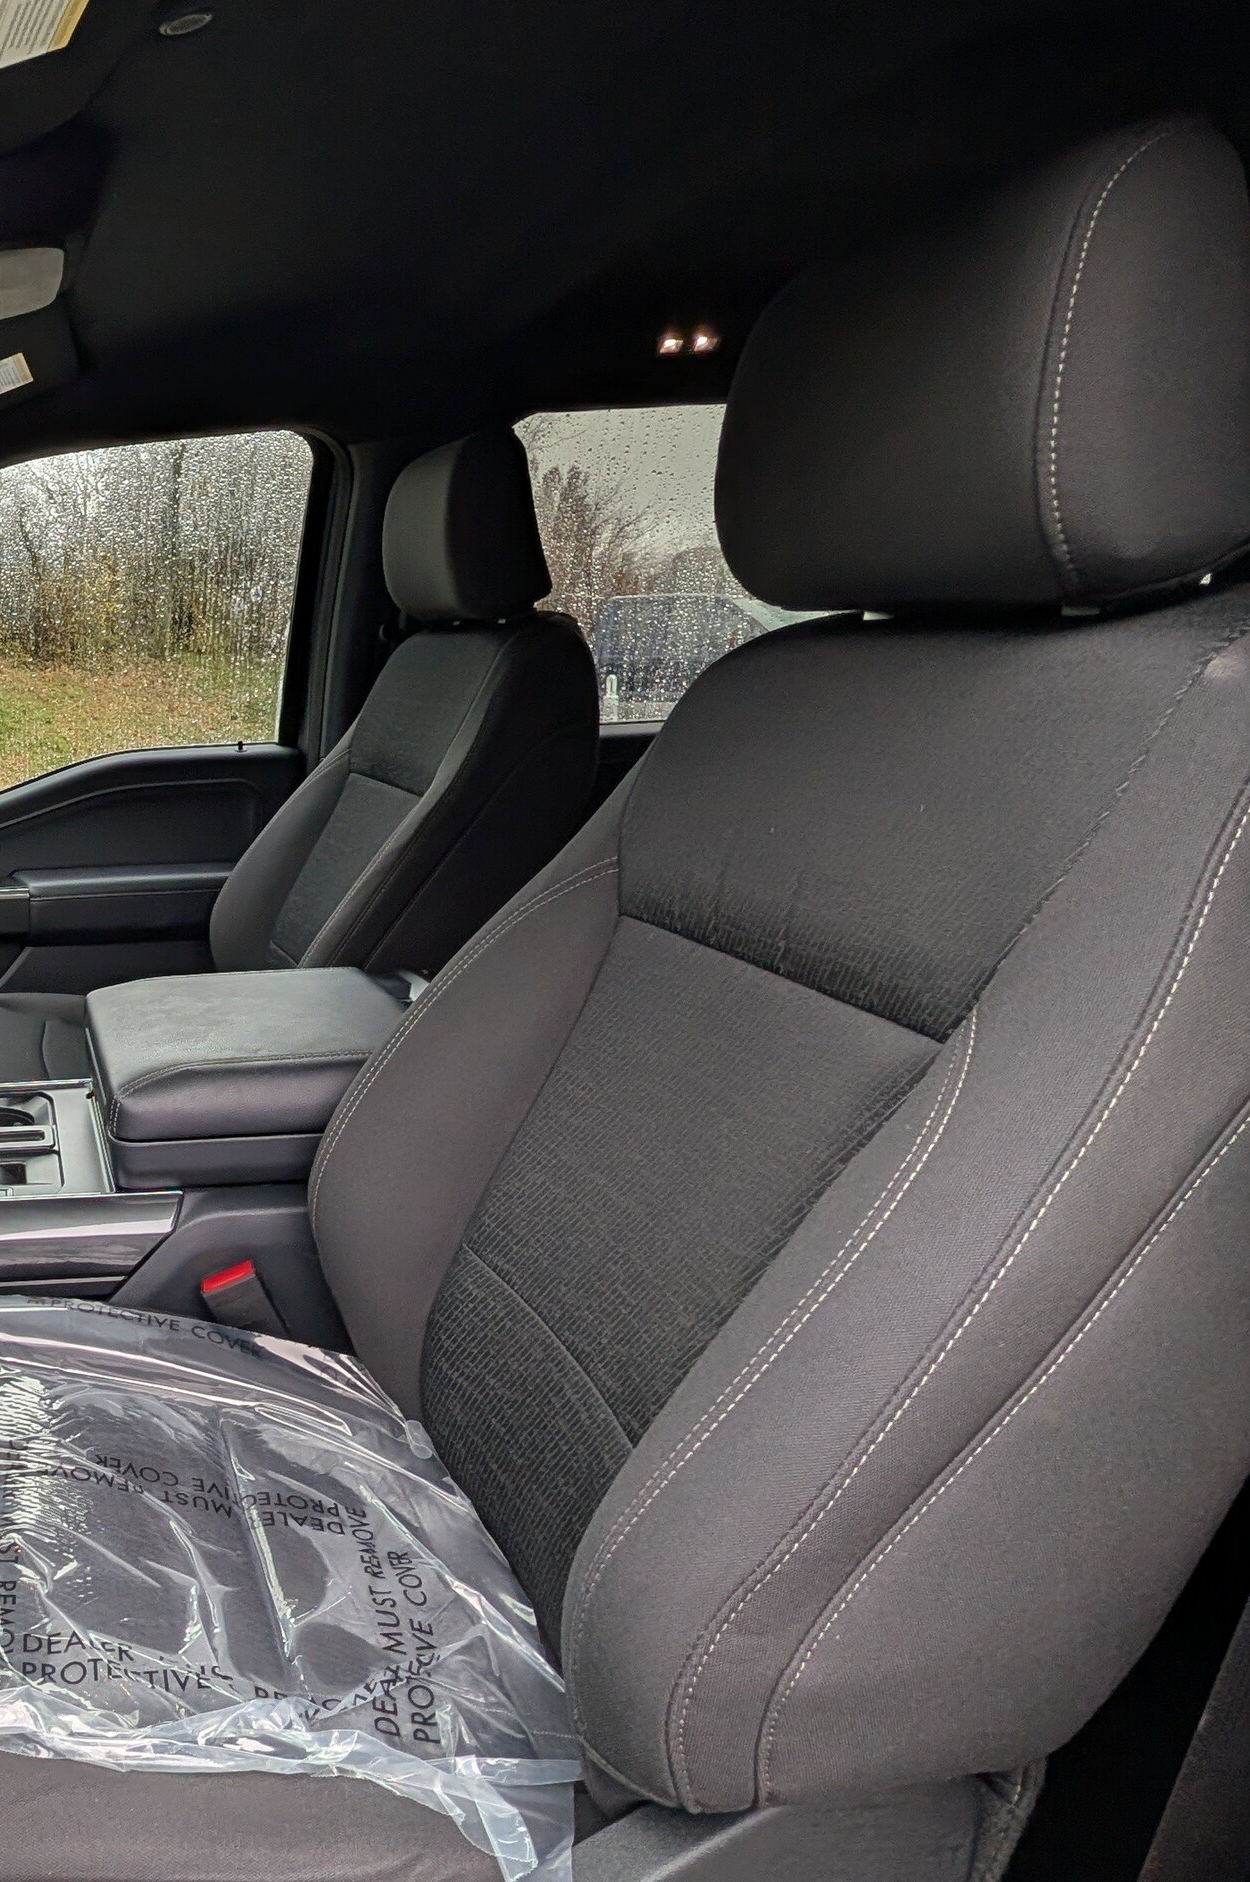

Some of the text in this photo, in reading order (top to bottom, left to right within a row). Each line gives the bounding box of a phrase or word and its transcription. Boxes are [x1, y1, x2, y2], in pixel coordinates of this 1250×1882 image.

[51, 1297, 180, 1332] PROTECTIVE
[94, 1453, 179, 1487] COVER
[158, 1490, 233, 1519] MUST
[252, 1510, 347, 1536] DEALE
[345, 1506, 387, 1579] REMOVE
[386, 1550, 427, 1607] COVER
[368, 1585, 407, 1656] MUST
